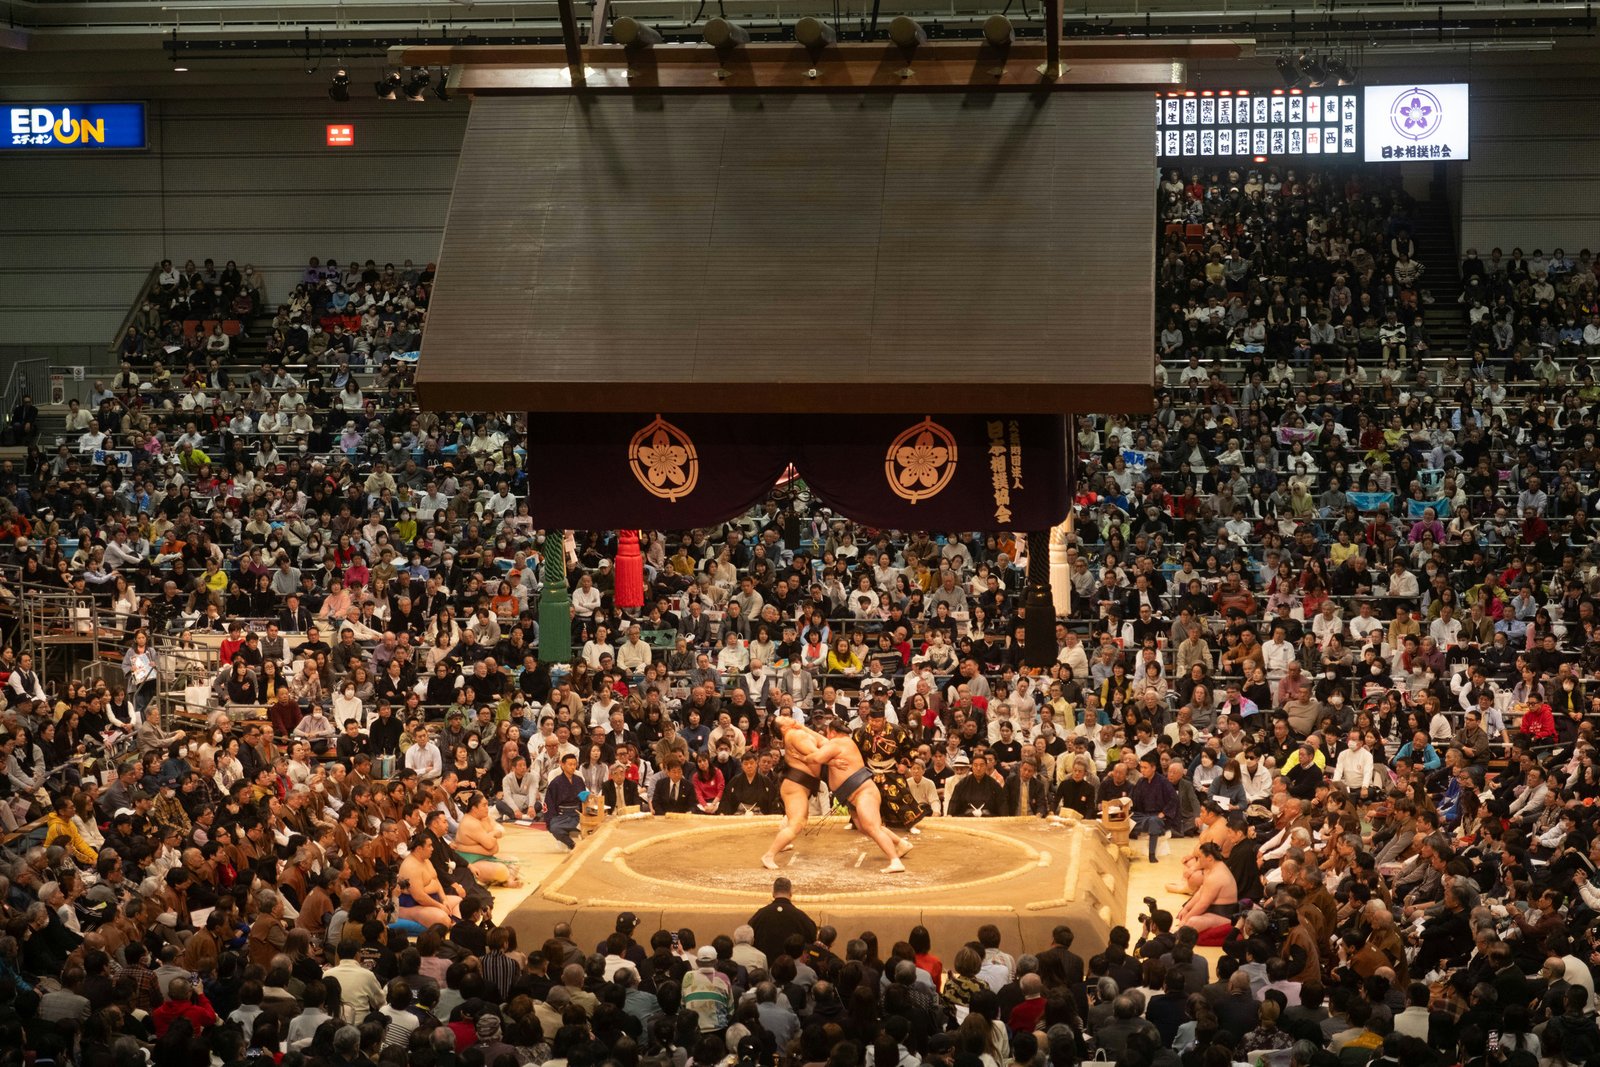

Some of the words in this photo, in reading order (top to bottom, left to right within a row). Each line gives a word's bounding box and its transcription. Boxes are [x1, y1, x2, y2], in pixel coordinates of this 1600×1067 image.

[1168, 101, 1178, 123] 明生
[1327, 100, 1336, 113] 東
[10, 107, 105, 144] EDION
[12, 134, 53, 144] エディオン
[1326, 132, 1336, 144] 西
[1381, 144, 1452, 159] 日本相撲協会
[987, 420, 1012, 523] 日本相撲協会
